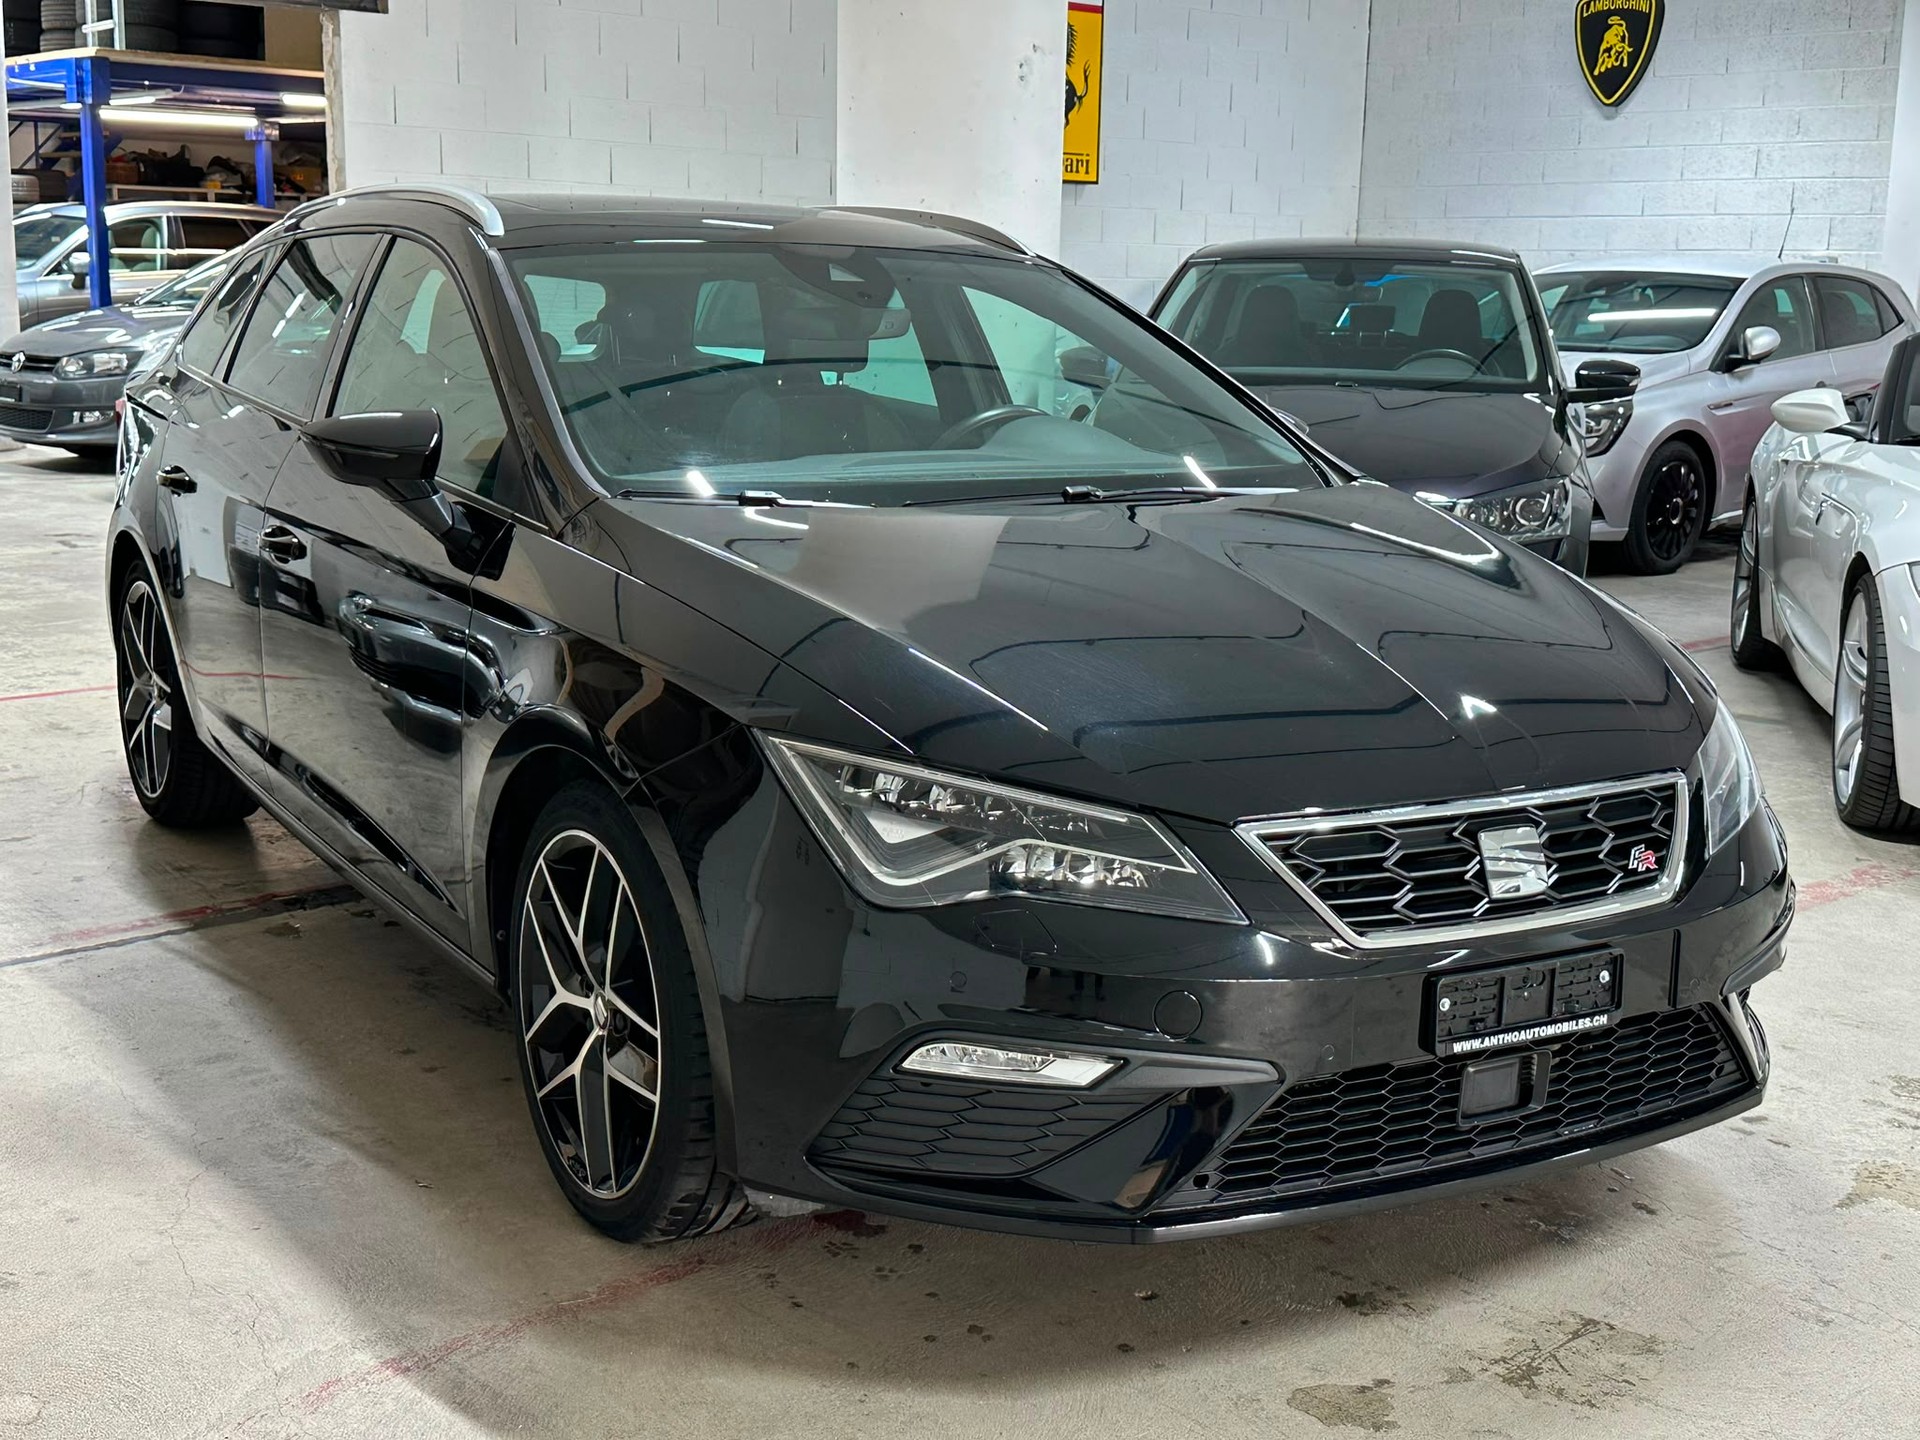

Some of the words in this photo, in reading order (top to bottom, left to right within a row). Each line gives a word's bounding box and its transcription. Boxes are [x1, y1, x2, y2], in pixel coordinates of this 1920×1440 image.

[1583, 0, 1650, 17] LAMBORGHINI
[1063, 153, 1090, 175] ari
[1628, 844, 1658, 872] FR
[1453, 1014, 1607, 1053] WWW.ANTHOAUTOMOBILES.CH
